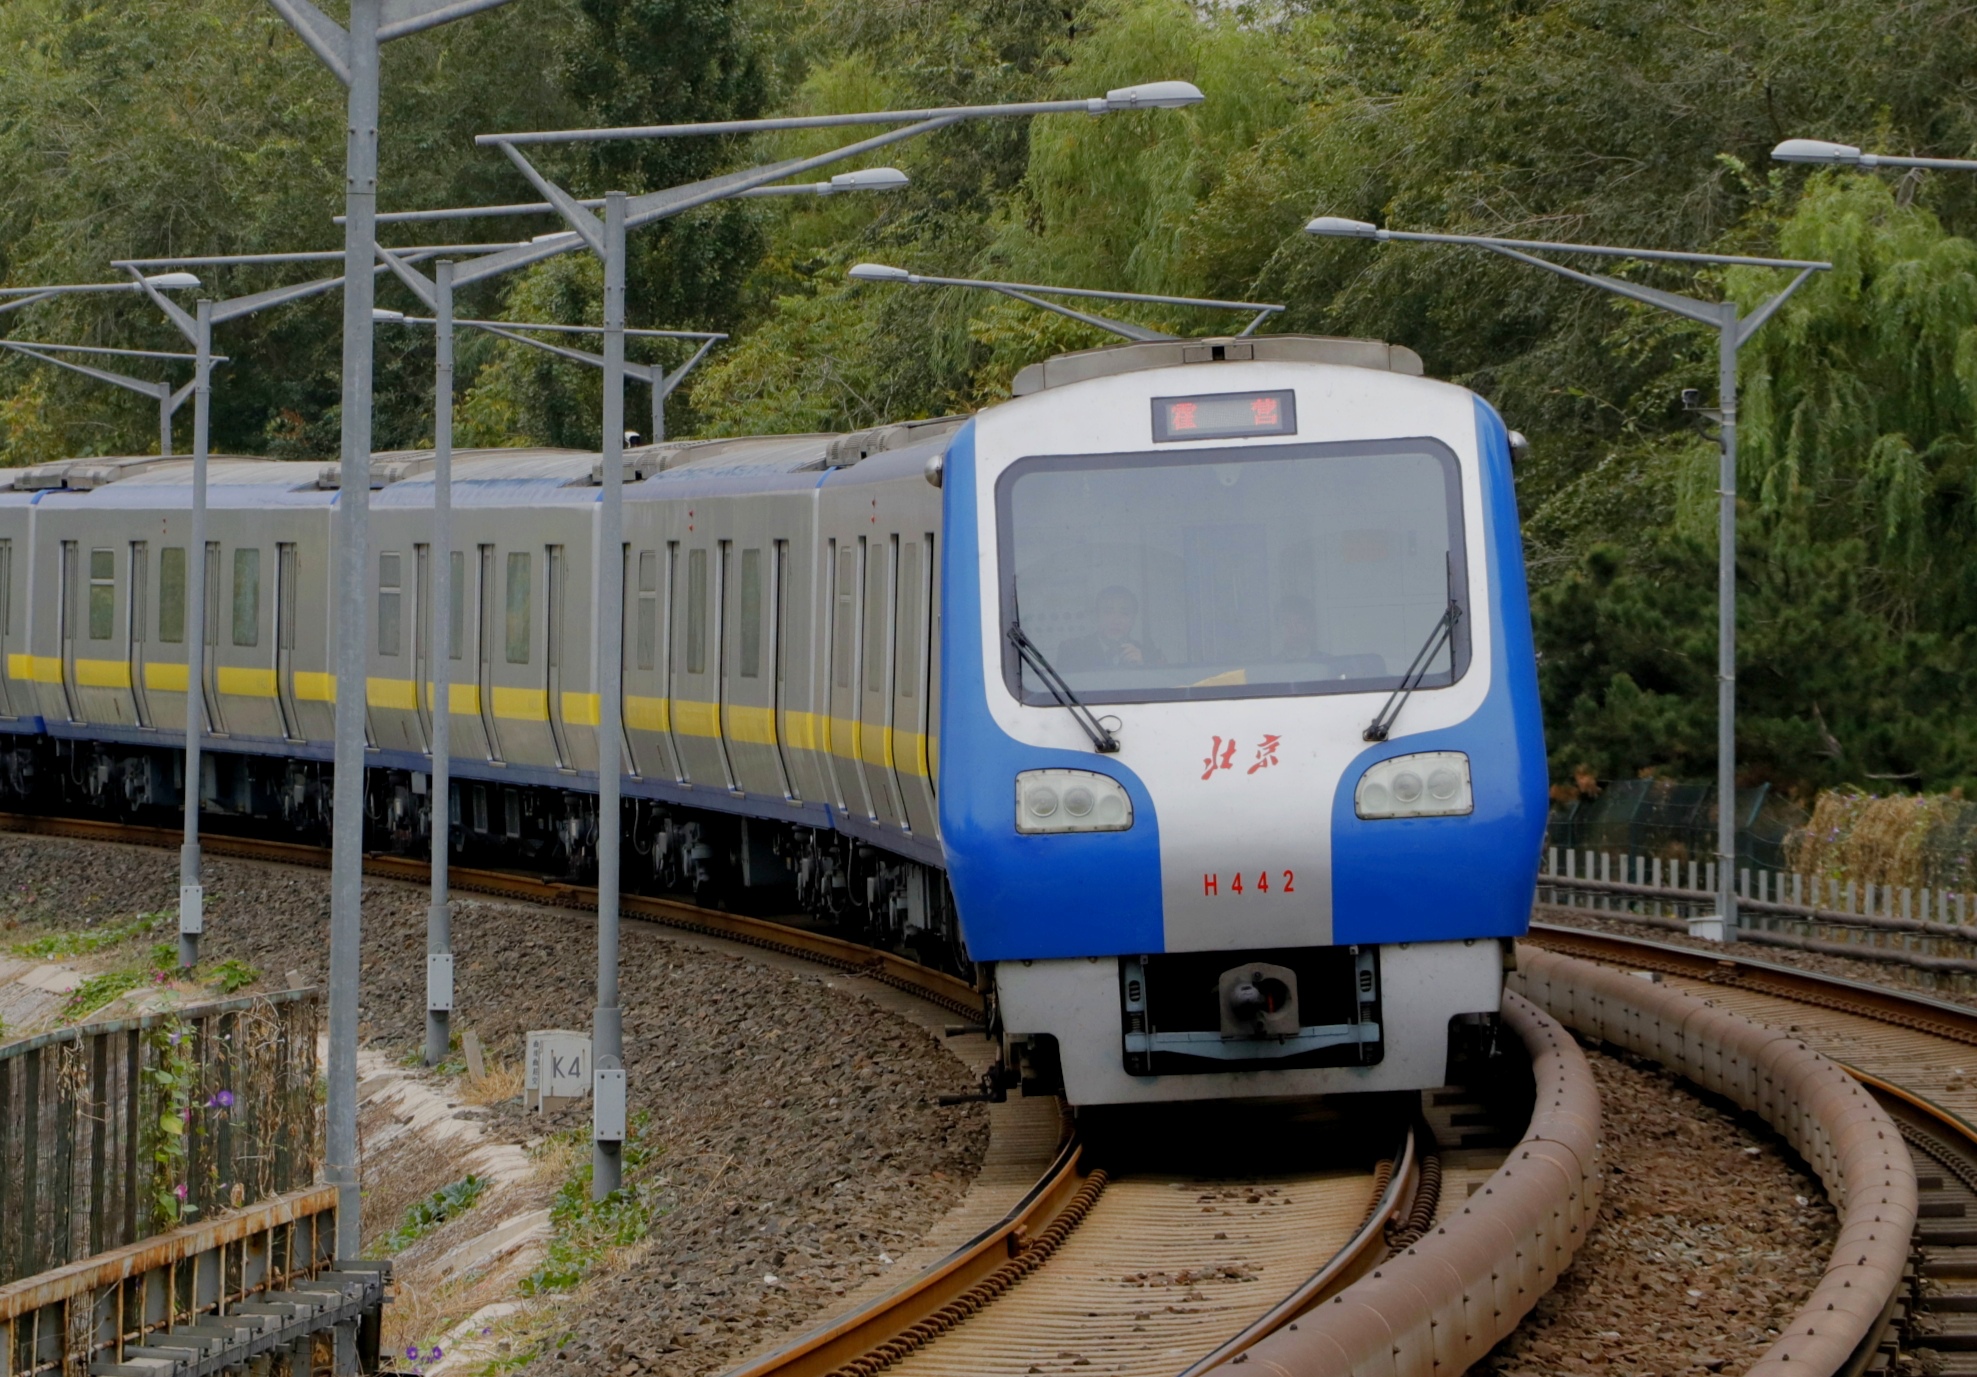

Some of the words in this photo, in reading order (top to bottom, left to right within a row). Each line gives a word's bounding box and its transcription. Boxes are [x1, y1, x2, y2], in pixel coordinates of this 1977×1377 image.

[1201, 734, 1282, 780] 北京
[1203, 869, 1295, 896] H442
[553, 1056, 581, 1079] K4
